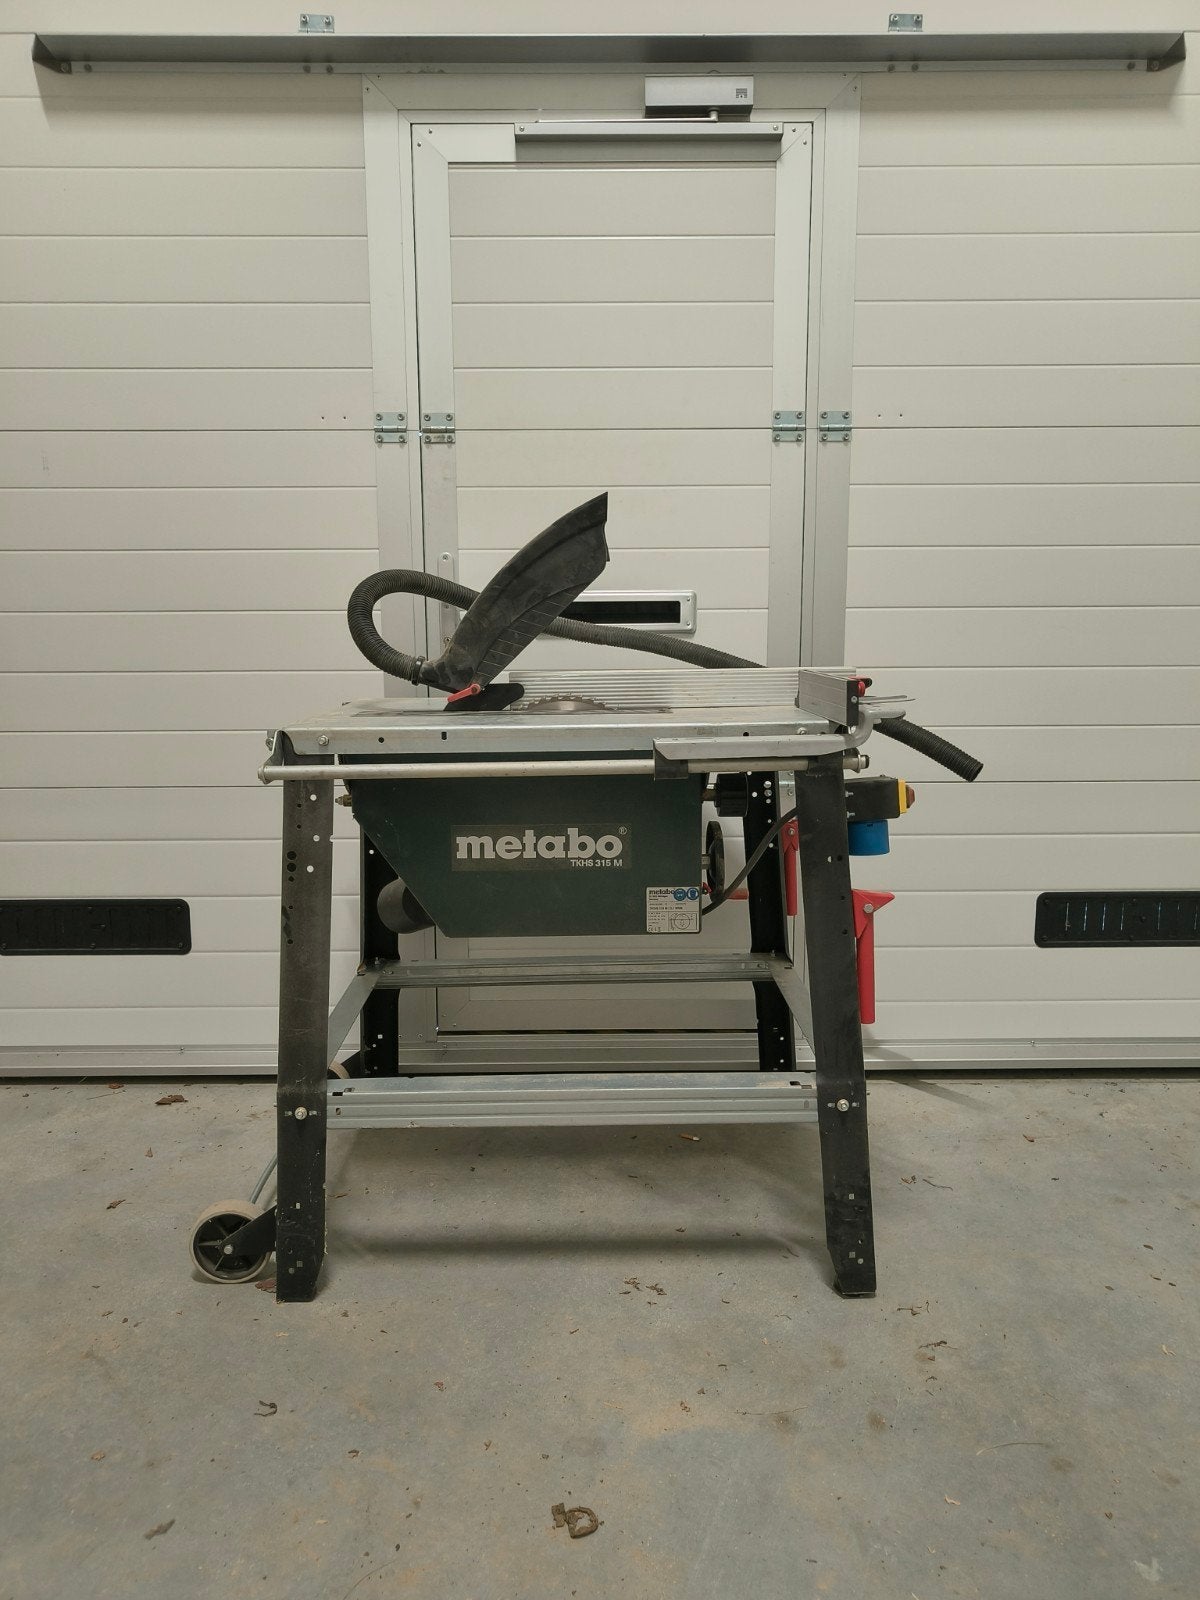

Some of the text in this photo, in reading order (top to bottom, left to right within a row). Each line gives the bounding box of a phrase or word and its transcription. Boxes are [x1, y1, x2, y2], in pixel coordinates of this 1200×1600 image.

[456, 827, 623, 860] metabo
[570, 859, 623, 867] TKHS 315 M
